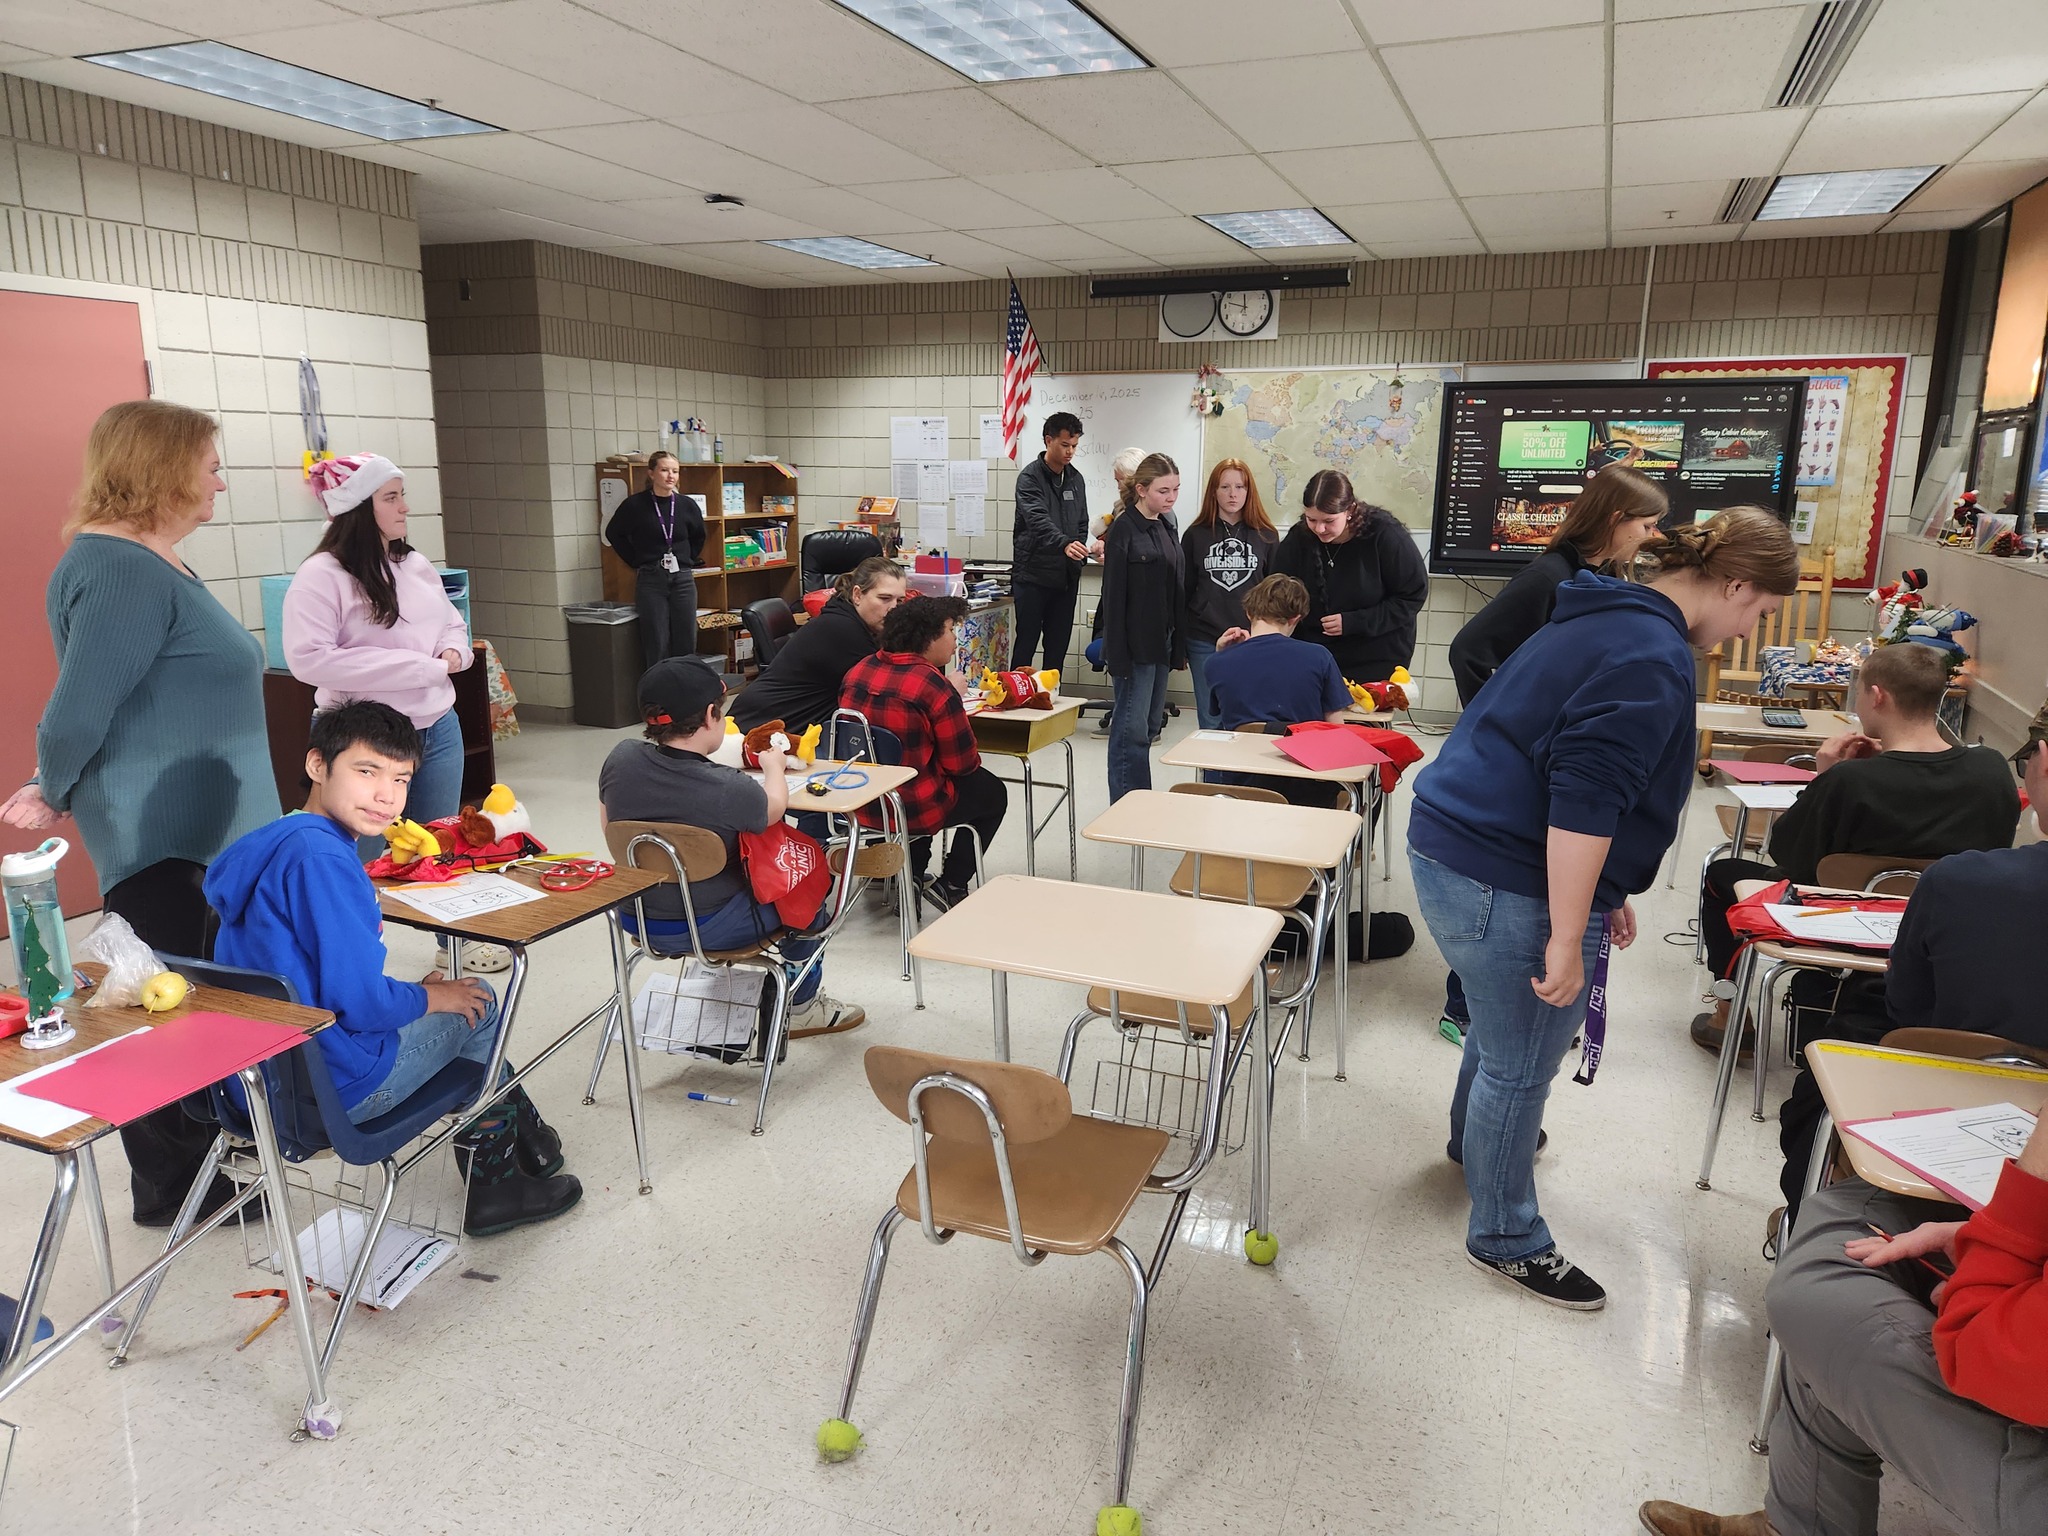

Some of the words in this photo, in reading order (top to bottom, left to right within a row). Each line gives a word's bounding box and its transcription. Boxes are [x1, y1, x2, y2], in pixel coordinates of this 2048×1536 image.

[1808, 379, 1843, 390] GUAGE
[1040, 389, 1093, 406] December
[1110, 388, 1141, 399] 2025
[1523, 437, 1546, 448] 50%
[1549, 437, 1567, 448] OFF
[1521, 448, 1566, 458] UNLIMITED
[1497, 513, 1530, 521] CLASSIC
[1204, 556, 1246, 569] RIVERSIDE
[1248, 556, 1258, 568] FC
[1598, 932, 1609, 959] GCU
[1589, 984, 1605, 1013] GCU
[1590, 1043, 1602, 1070] GCU
